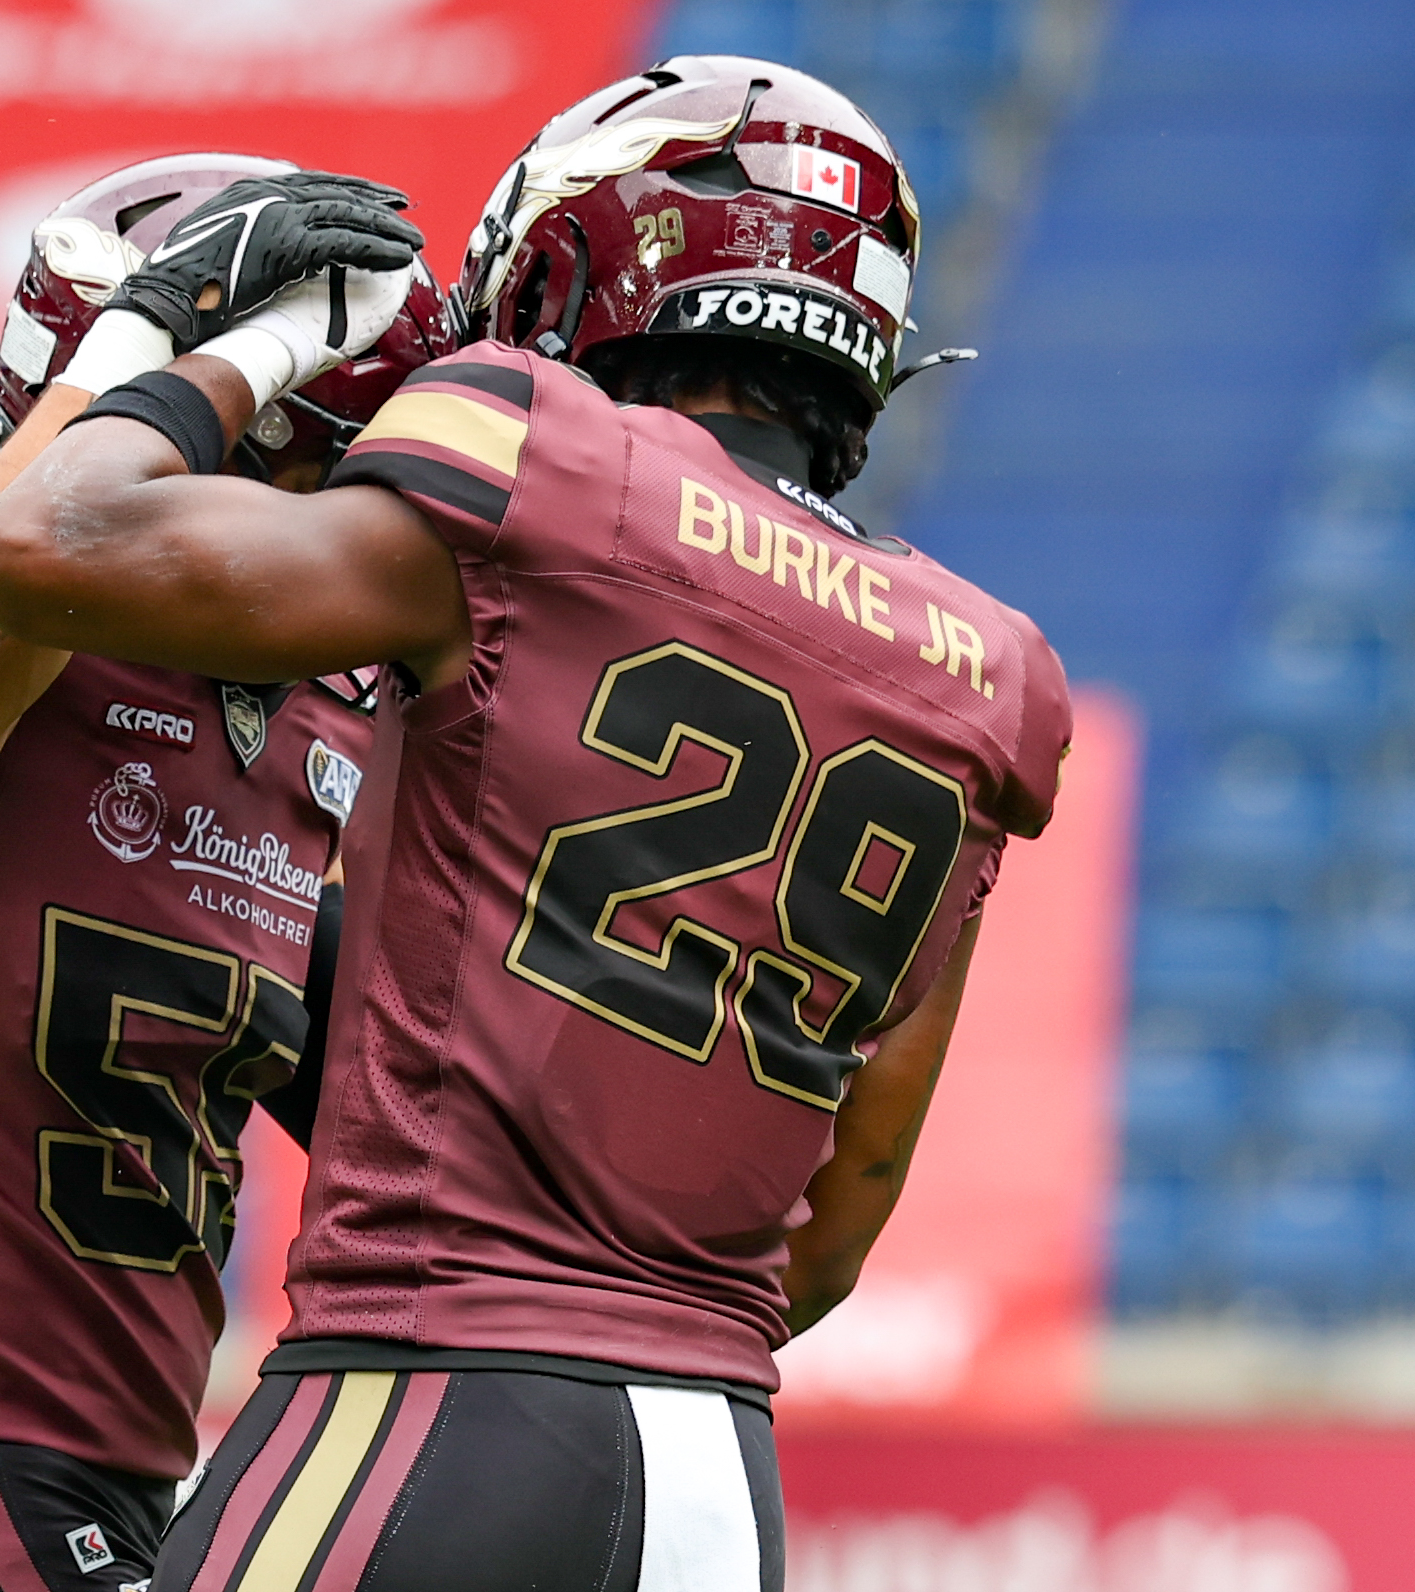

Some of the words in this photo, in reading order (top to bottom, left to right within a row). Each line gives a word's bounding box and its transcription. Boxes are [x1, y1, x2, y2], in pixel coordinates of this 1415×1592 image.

[633, 207, 686, 266] 29
[692, 289, 887, 384] FORELLE
[676, 475, 895, 642] BURKE
[918, 601, 997, 701] JR.
[187, 884, 312, 947] ALKOHOLFREI
[503, 637, 971, 1115] 29
